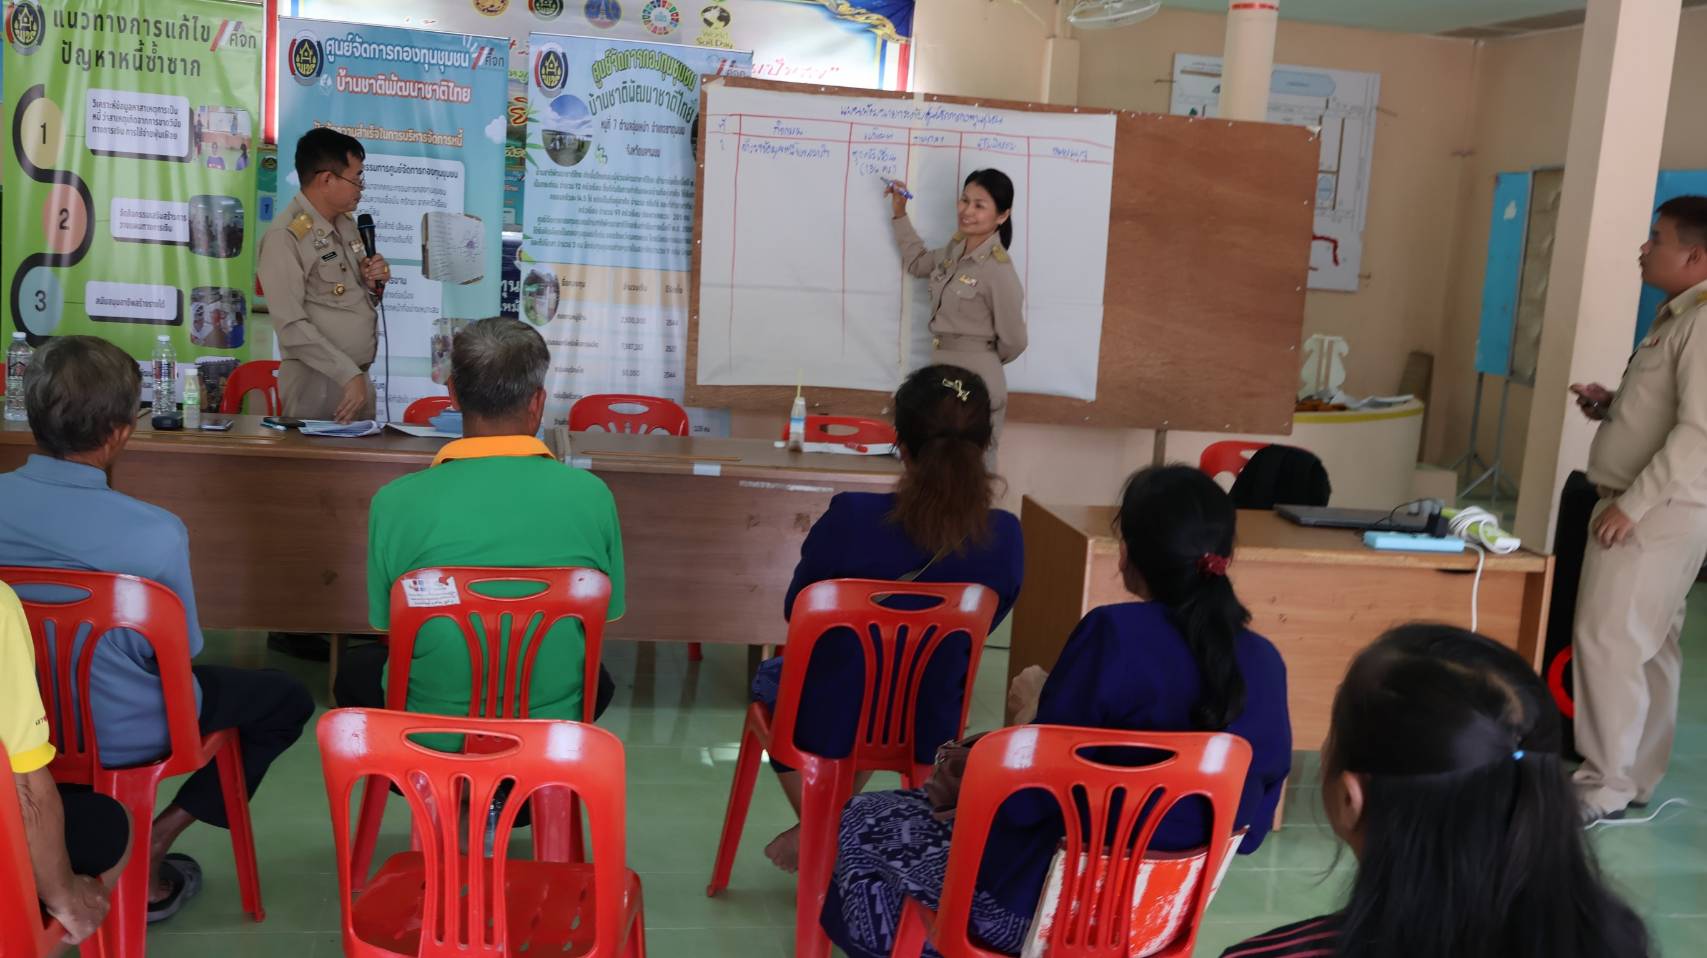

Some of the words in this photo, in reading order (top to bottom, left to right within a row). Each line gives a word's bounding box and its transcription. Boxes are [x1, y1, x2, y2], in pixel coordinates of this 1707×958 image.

[53, 9, 211, 43] แนวทางการแก้ไข
[61, 40, 201, 77] ปัญหาหนี้ซ้ำซาก
[325, 33, 470, 73] ศูนย์จัดการกองทุนชุมชน
[592, 47, 698, 92] ศูนย์จัดการกองทุนชุมชน
[336, 67, 471, 102] บ้านชาติพัฒนาชาติไทย
[588, 79, 695, 124] บ้านชาติพัฒนาชาติไทย
[40, 122, 48, 145] 1
[58, 207, 70, 231] 2
[34, 289, 47, 312] 3
